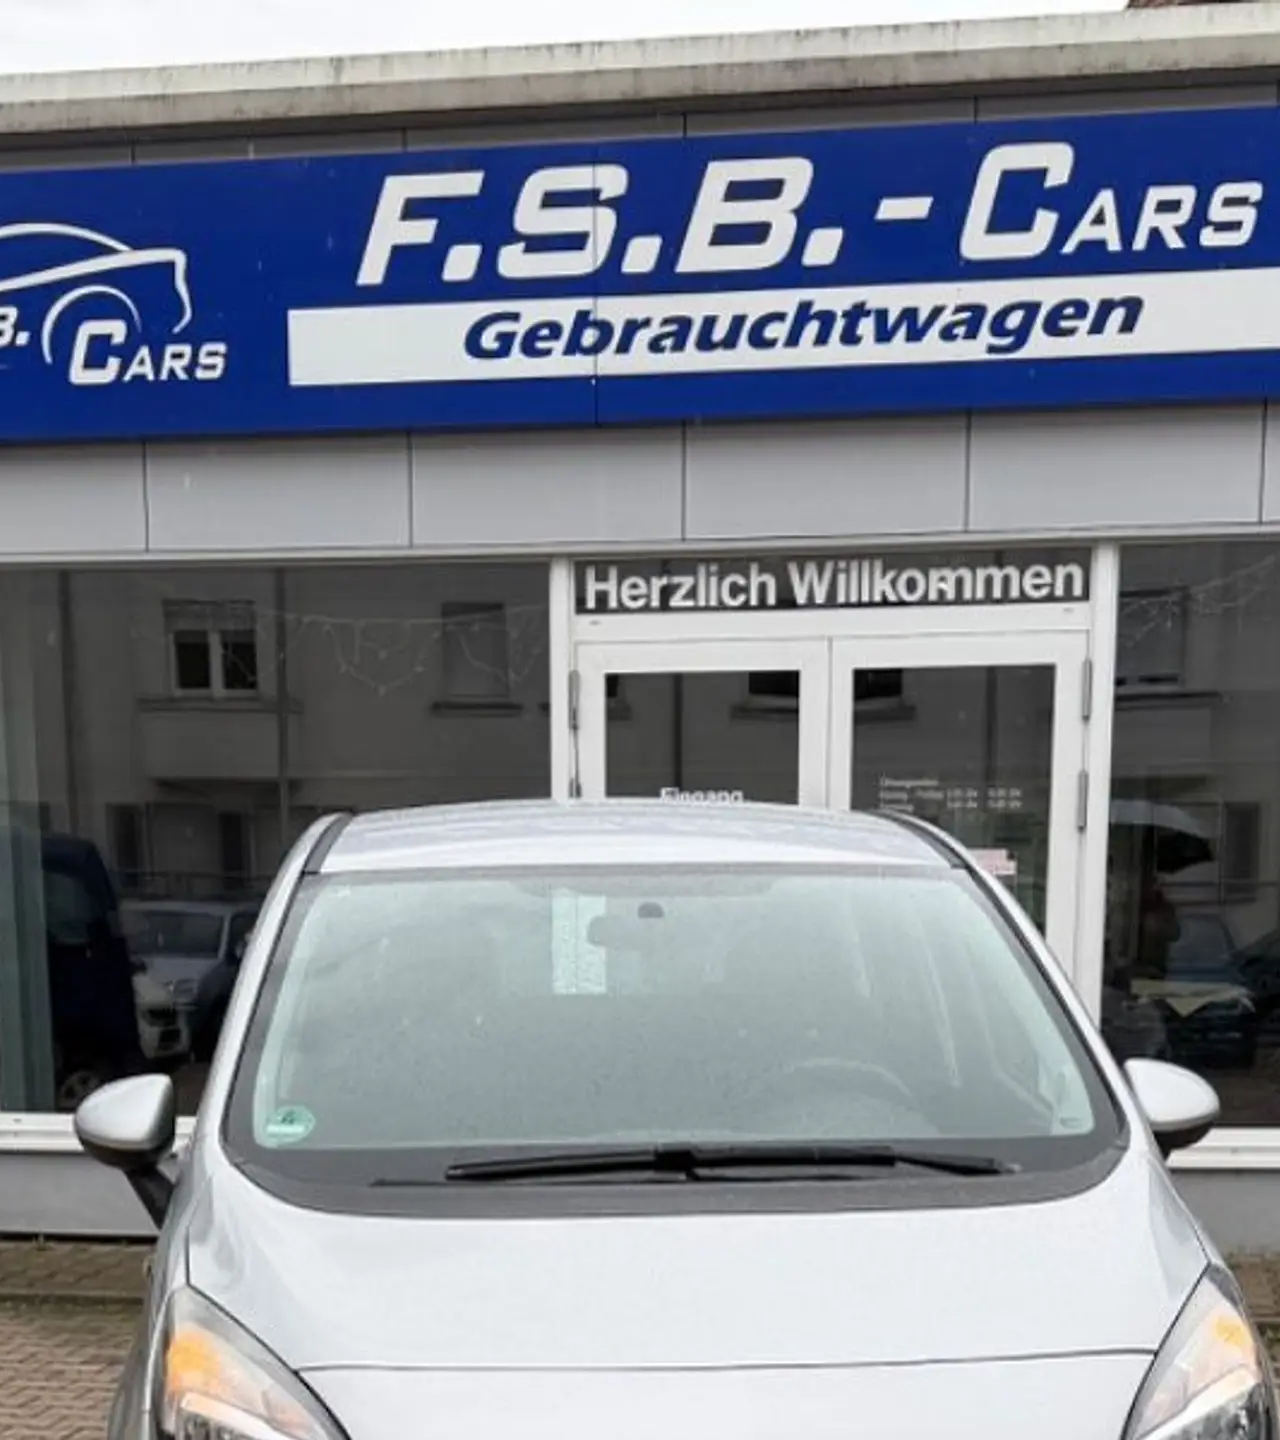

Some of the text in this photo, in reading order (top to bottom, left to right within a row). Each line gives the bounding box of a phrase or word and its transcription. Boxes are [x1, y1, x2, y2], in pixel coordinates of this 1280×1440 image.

[69, 318, 227, 386] CARS
[464, 296, 1144, 360] Gebrauchtwagen
[585, 560, 1084, 609] Herzlich Willkommen
